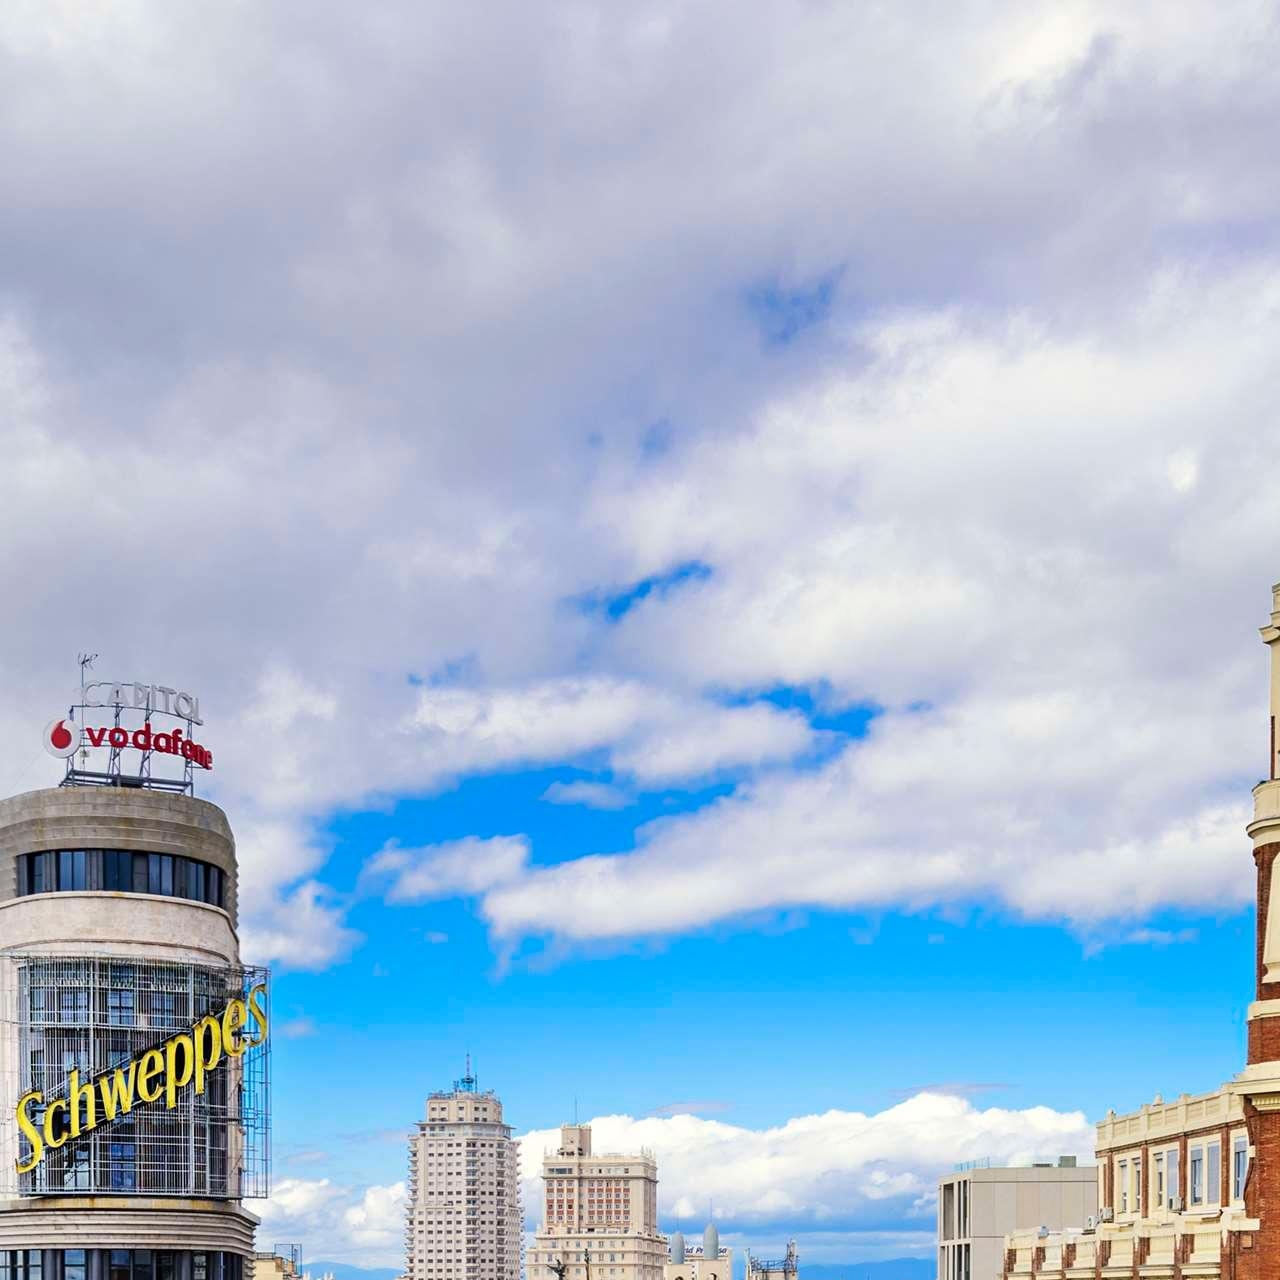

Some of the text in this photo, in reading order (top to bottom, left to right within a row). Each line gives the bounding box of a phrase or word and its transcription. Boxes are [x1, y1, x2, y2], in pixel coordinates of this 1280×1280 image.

[82, 681, 204, 726] CAPITOL
[86, 722, 212, 770] vodafone
[15, 982, 267, 1174] Schweppes
